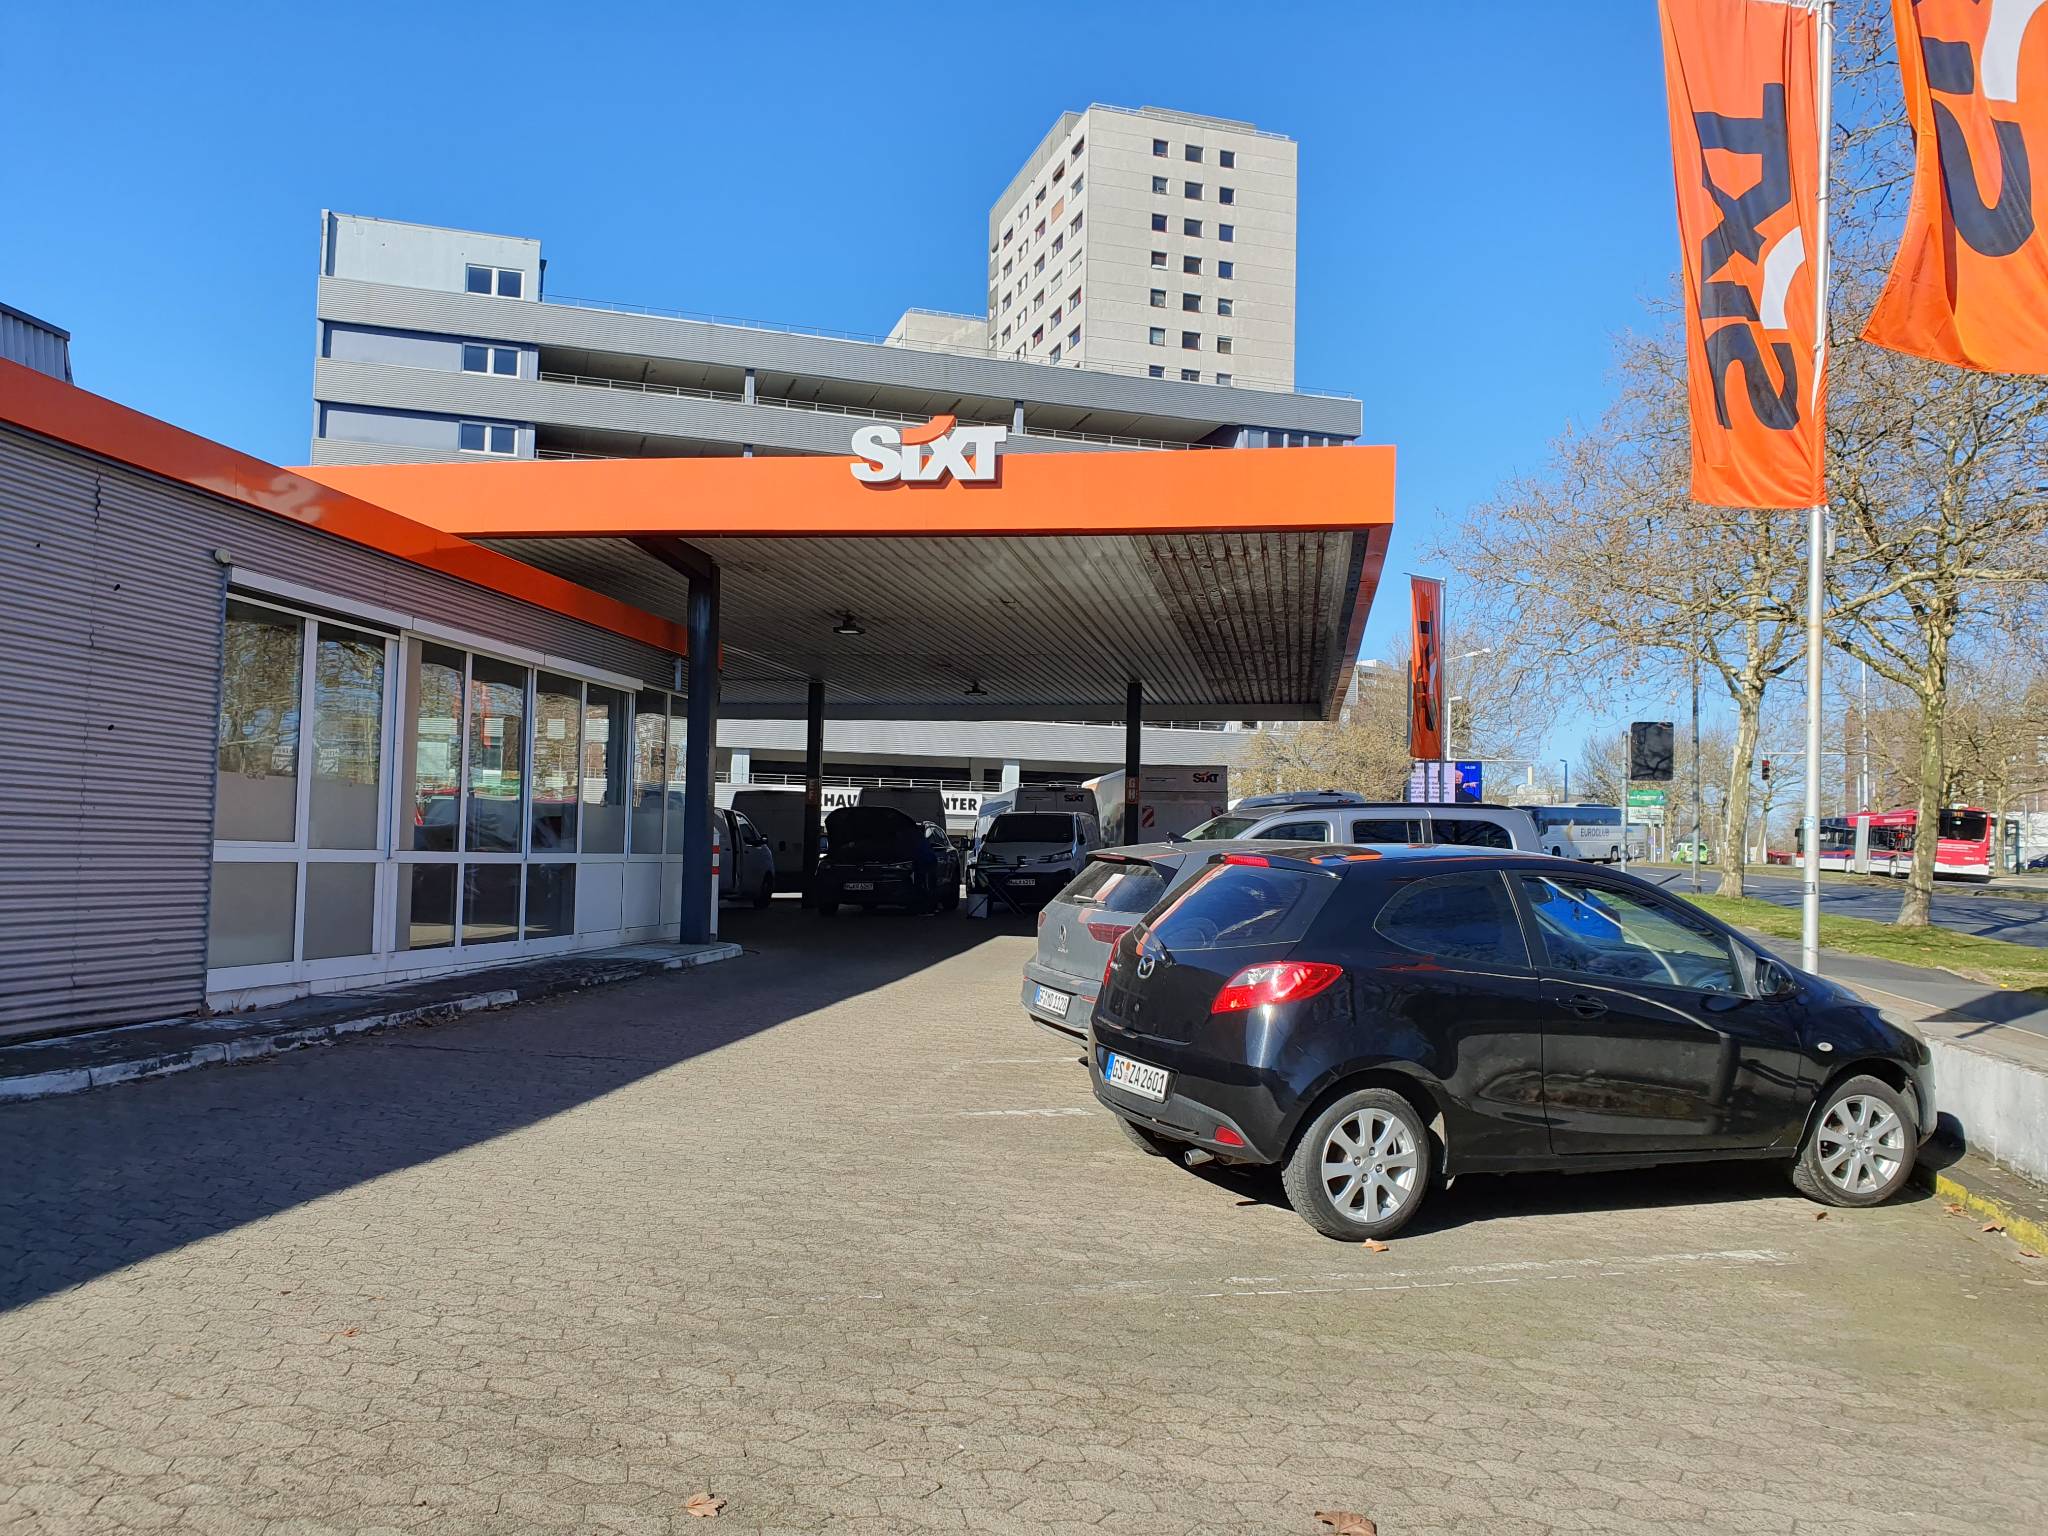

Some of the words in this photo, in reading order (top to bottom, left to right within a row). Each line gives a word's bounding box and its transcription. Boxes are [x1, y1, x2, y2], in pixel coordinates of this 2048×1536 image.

[1693, 83, 1805, 430] SIXT
[850, 415, 1006, 482] SIXT
[1191, 771, 1219, 783] SIXT
[1112, 1059, 1125, 1079] GS
